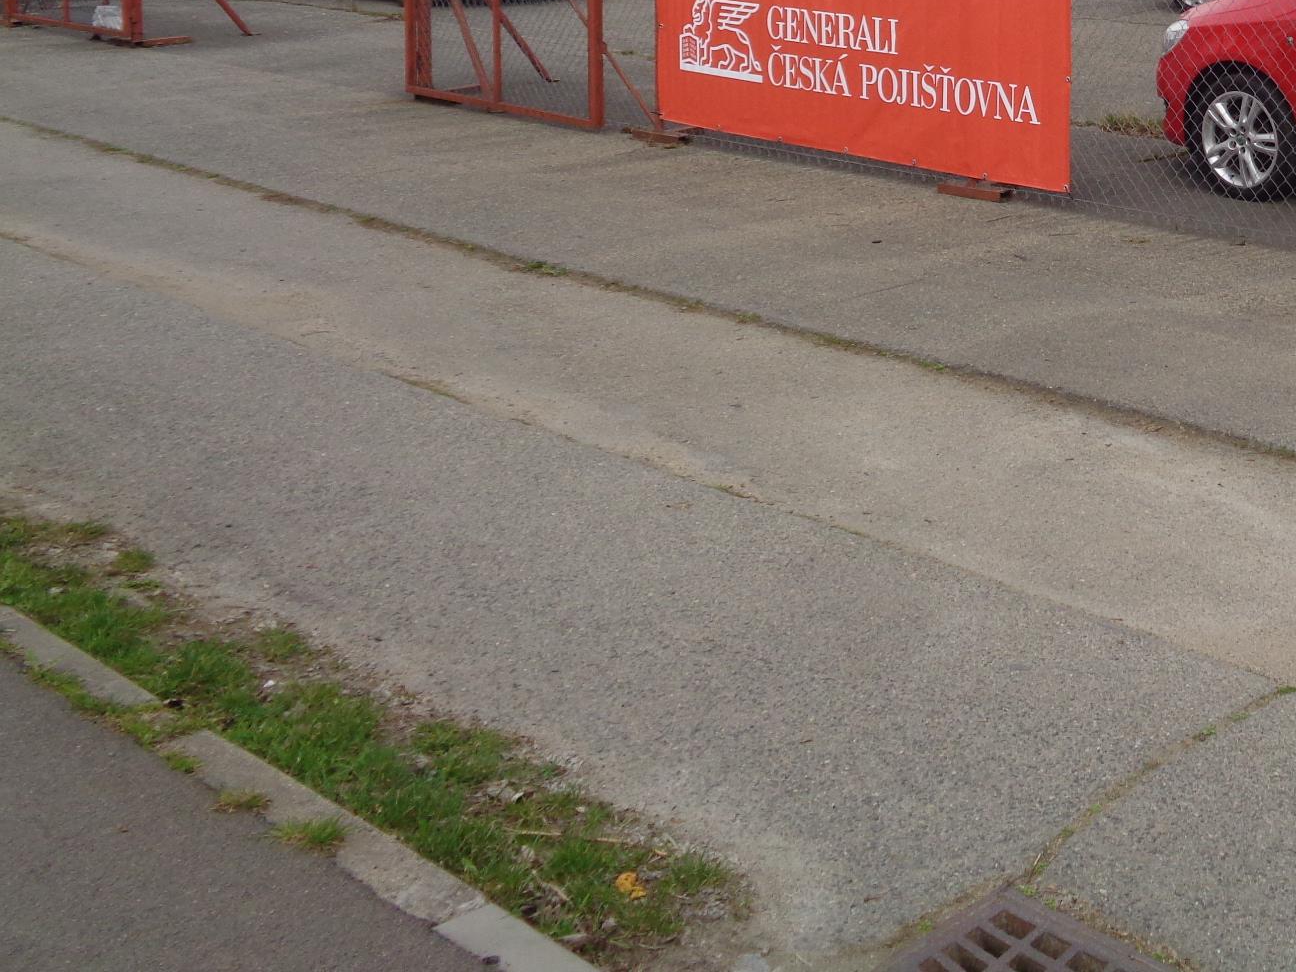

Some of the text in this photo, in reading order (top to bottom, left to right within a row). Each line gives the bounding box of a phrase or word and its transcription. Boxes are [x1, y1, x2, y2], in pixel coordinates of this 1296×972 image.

[766, 5, 898, 55] GENERALI
[767, 44, 1041, 125] ČESKÁ POJIŠŤOVNA
